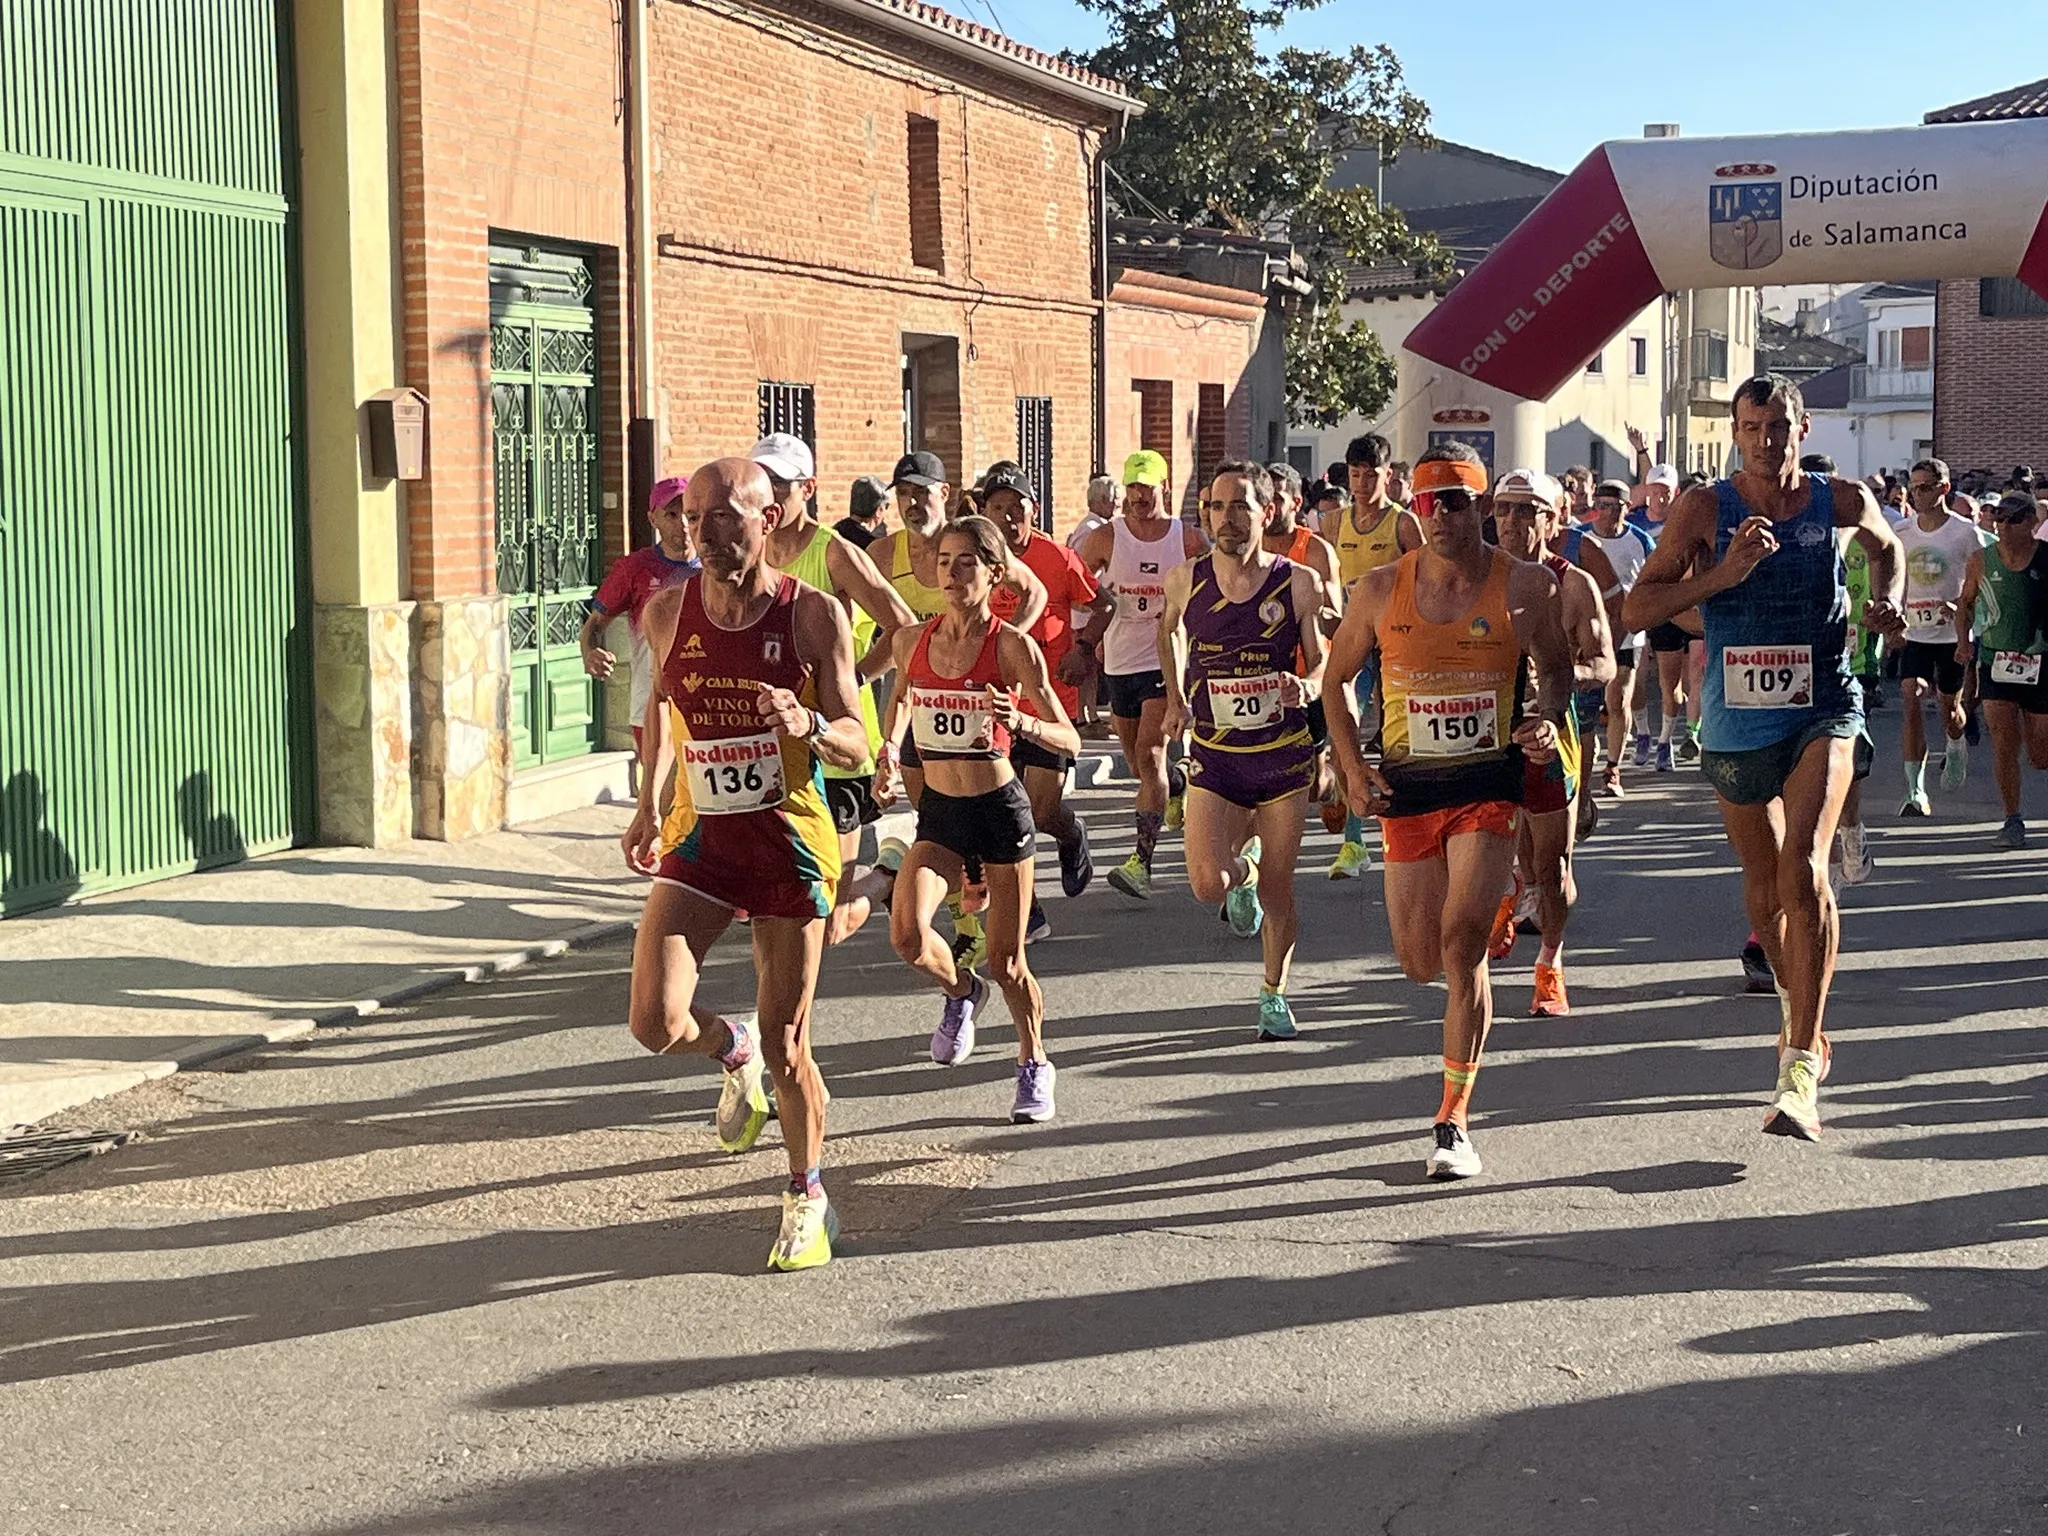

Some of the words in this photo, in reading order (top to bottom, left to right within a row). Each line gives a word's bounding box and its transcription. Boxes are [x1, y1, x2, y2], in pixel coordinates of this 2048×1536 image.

[1790, 168, 1938, 203] Diputación
[1789, 230, 1813, 248] de
[1824, 221, 1967, 246] Salamanca
[1459, 329, 1508, 376] CON
[1504, 307, 1537, 334] EL
[1532, 211, 1631, 307] DEPORTE
[1137, 597, 1148, 612] 8
[1917, 609, 1932, 623] 13
[1726, 650, 1809, 666] bedunia
[706, 678, 735, 688] CAJA
[1210, 678, 1280, 695] bedunia
[1744, 668, 1793, 692] 109
[704, 698, 751, 712] VINO
[1232, 697, 1260, 717] 20
[1408, 697, 1494, 714] bedunia
[692, 713, 713, 726] DE
[720, 713, 766, 727] TORO
[934, 712, 965, 737] 80
[1427, 716, 1480, 741] 150
[684, 741, 778, 764] bedunia
[704, 762, 763, 796] 136
